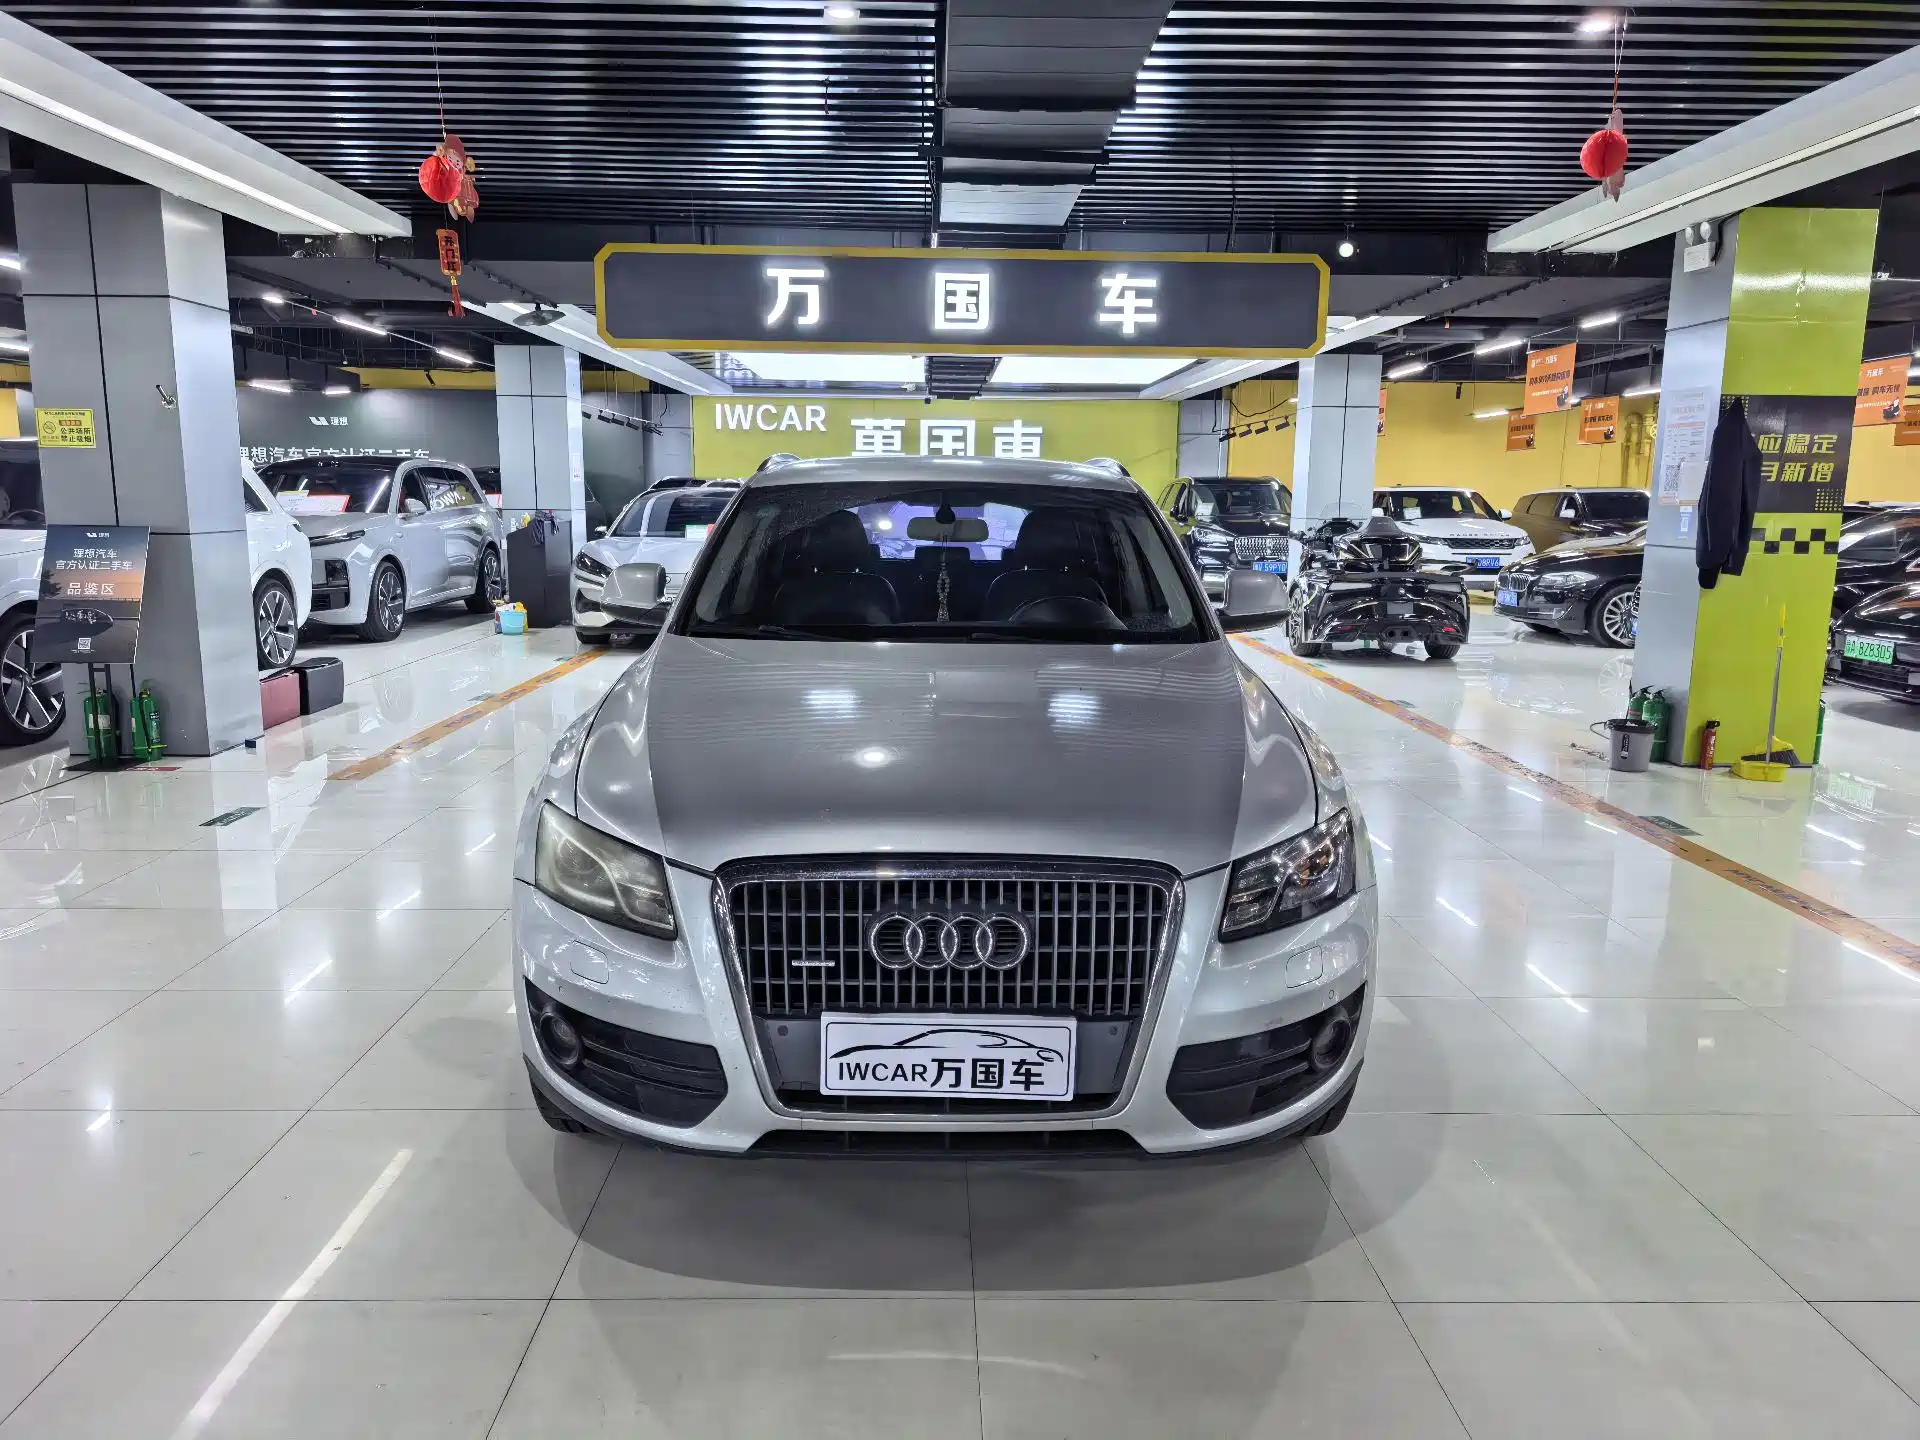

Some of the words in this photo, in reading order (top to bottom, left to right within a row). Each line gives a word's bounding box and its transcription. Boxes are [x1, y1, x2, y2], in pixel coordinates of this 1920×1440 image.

[765, 267, 1158, 336] 万国车
[330, 416, 348, 426] 理想
[715, 403, 827, 432] IWCAR
[60, 427, 91, 435] 公共场所
[73, 548, 118, 559] 理想汽车
[55, 559, 134, 571] 官方认证二手车
[67, 582, 115, 596] 品鉴区
